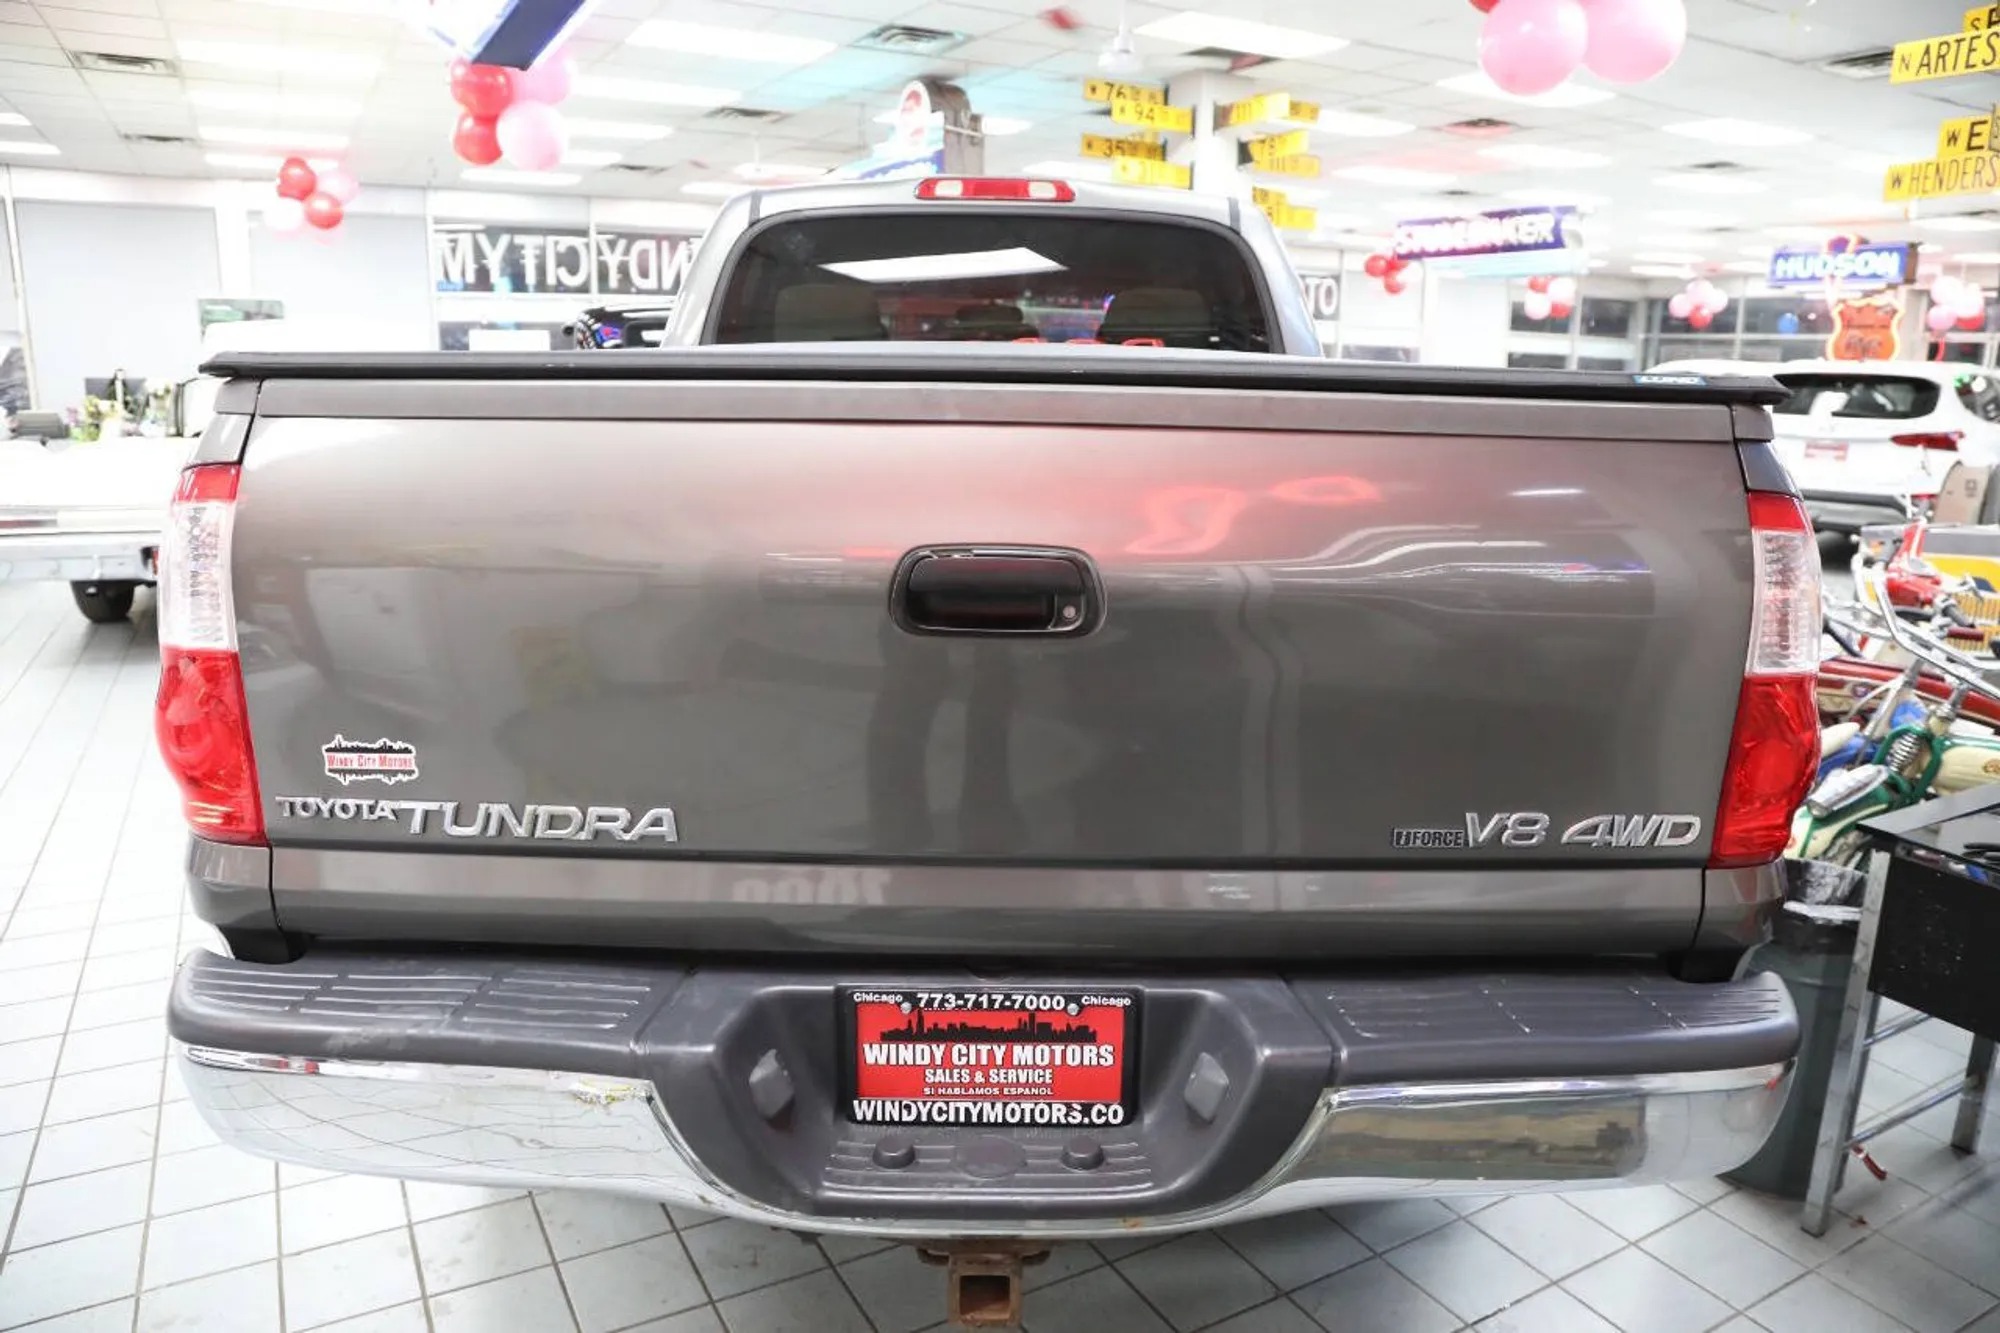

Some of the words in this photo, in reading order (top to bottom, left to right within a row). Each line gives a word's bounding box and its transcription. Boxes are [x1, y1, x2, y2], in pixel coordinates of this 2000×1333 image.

[1900, 54, 1912, 72] N
[1947, 128, 1960, 147] W
[1892, 174, 1905, 189] W
[1776, 250, 1900, 279] HUDSON
[357, 755, 376, 767] CITY
[379, 755, 412, 767] MOTORS
[275, 796, 400, 822] TOYOTA
[398, 800, 678, 843] TUNDRA
[1466, 811, 1551, 848] V8
[1561, 814, 1701, 848] 4WD
[853, 992, 903, 1004] Chicago
[917, 993, 1065, 1011] 773-717-7000
[1081, 995, 1131, 1007] Chicago
[863, 1043, 945, 1066] WINDY
[952, 1044, 1010, 1066] CITY
[1013, 1044, 1114, 1067] MOTORS
[925, 1069, 970, 1084] SALES
[975, 1070, 985, 1084] &
[989, 1069, 1053, 1084] SERVICE
[924, 1087, 935, 1095] SI
[939, 1087, 1000, 1096] HABLAMOS
[853, 1101, 1124, 1124] WINDYCITYMOTORS.CO
